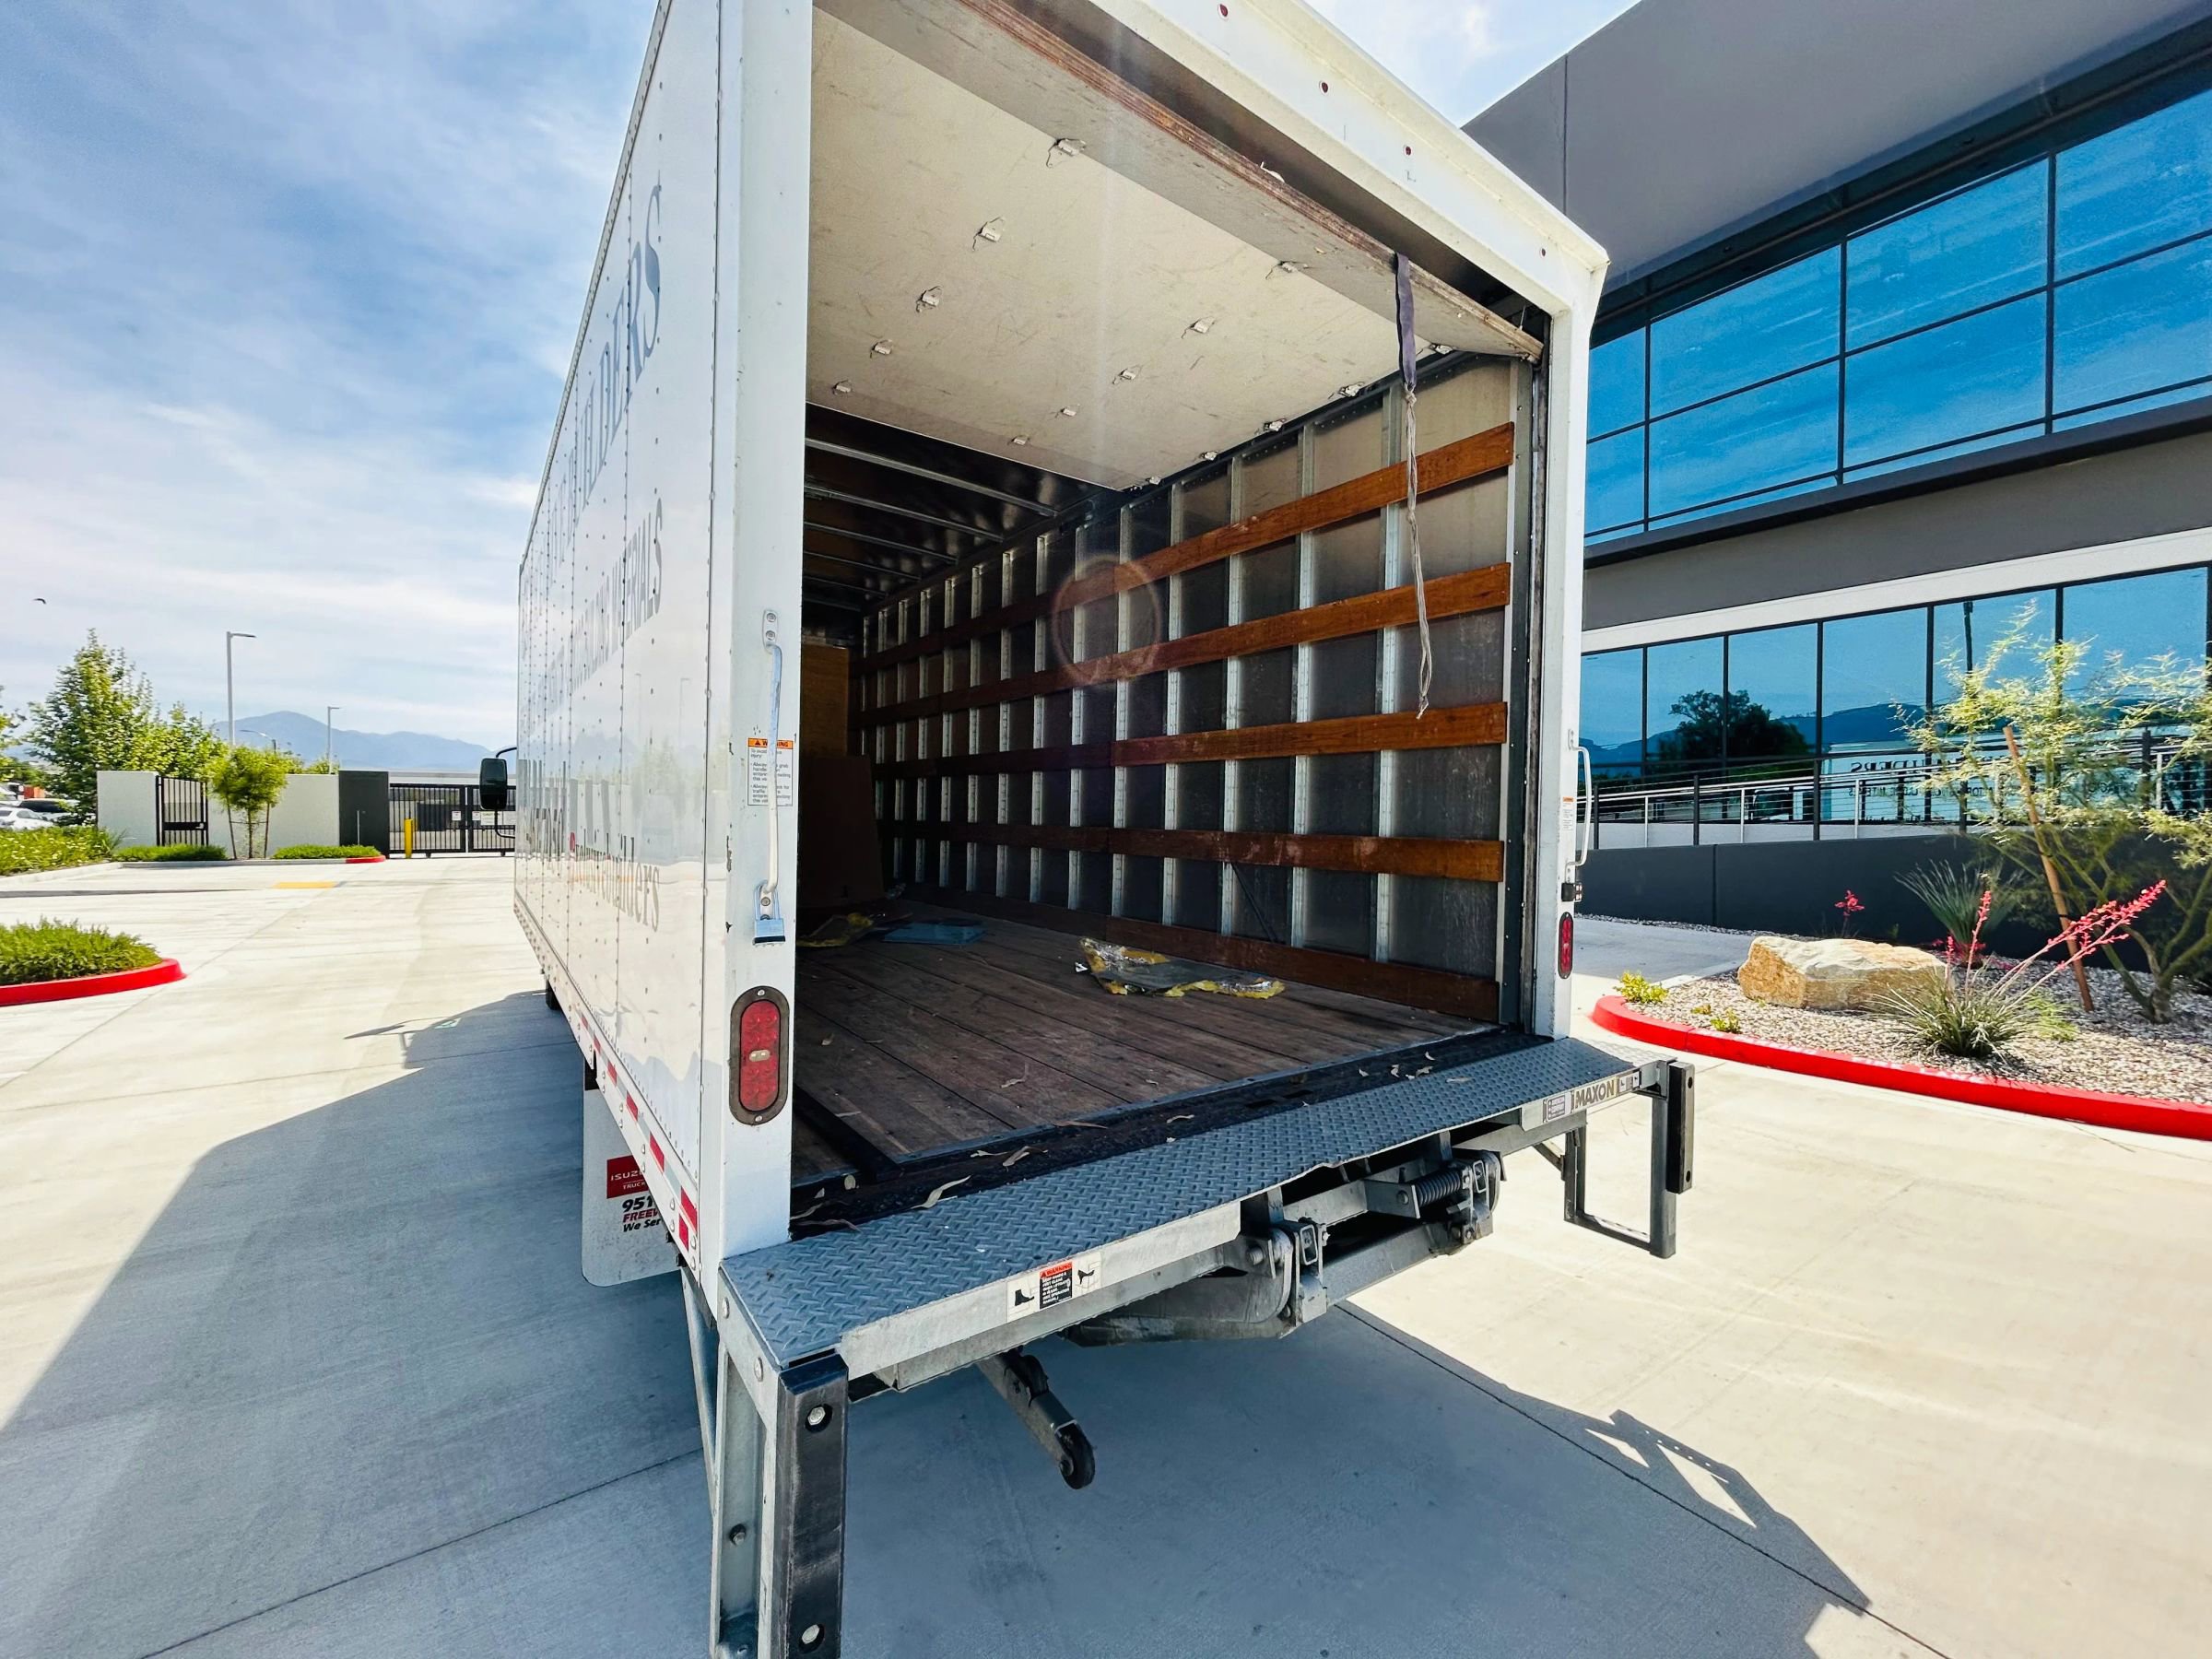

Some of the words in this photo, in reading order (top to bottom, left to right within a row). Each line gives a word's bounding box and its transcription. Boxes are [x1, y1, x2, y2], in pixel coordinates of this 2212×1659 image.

[1575, 1080, 1614, 1108] MAXON
[611, 1170, 643, 1181] ISUZ
[623, 1222, 641, 1232] We
